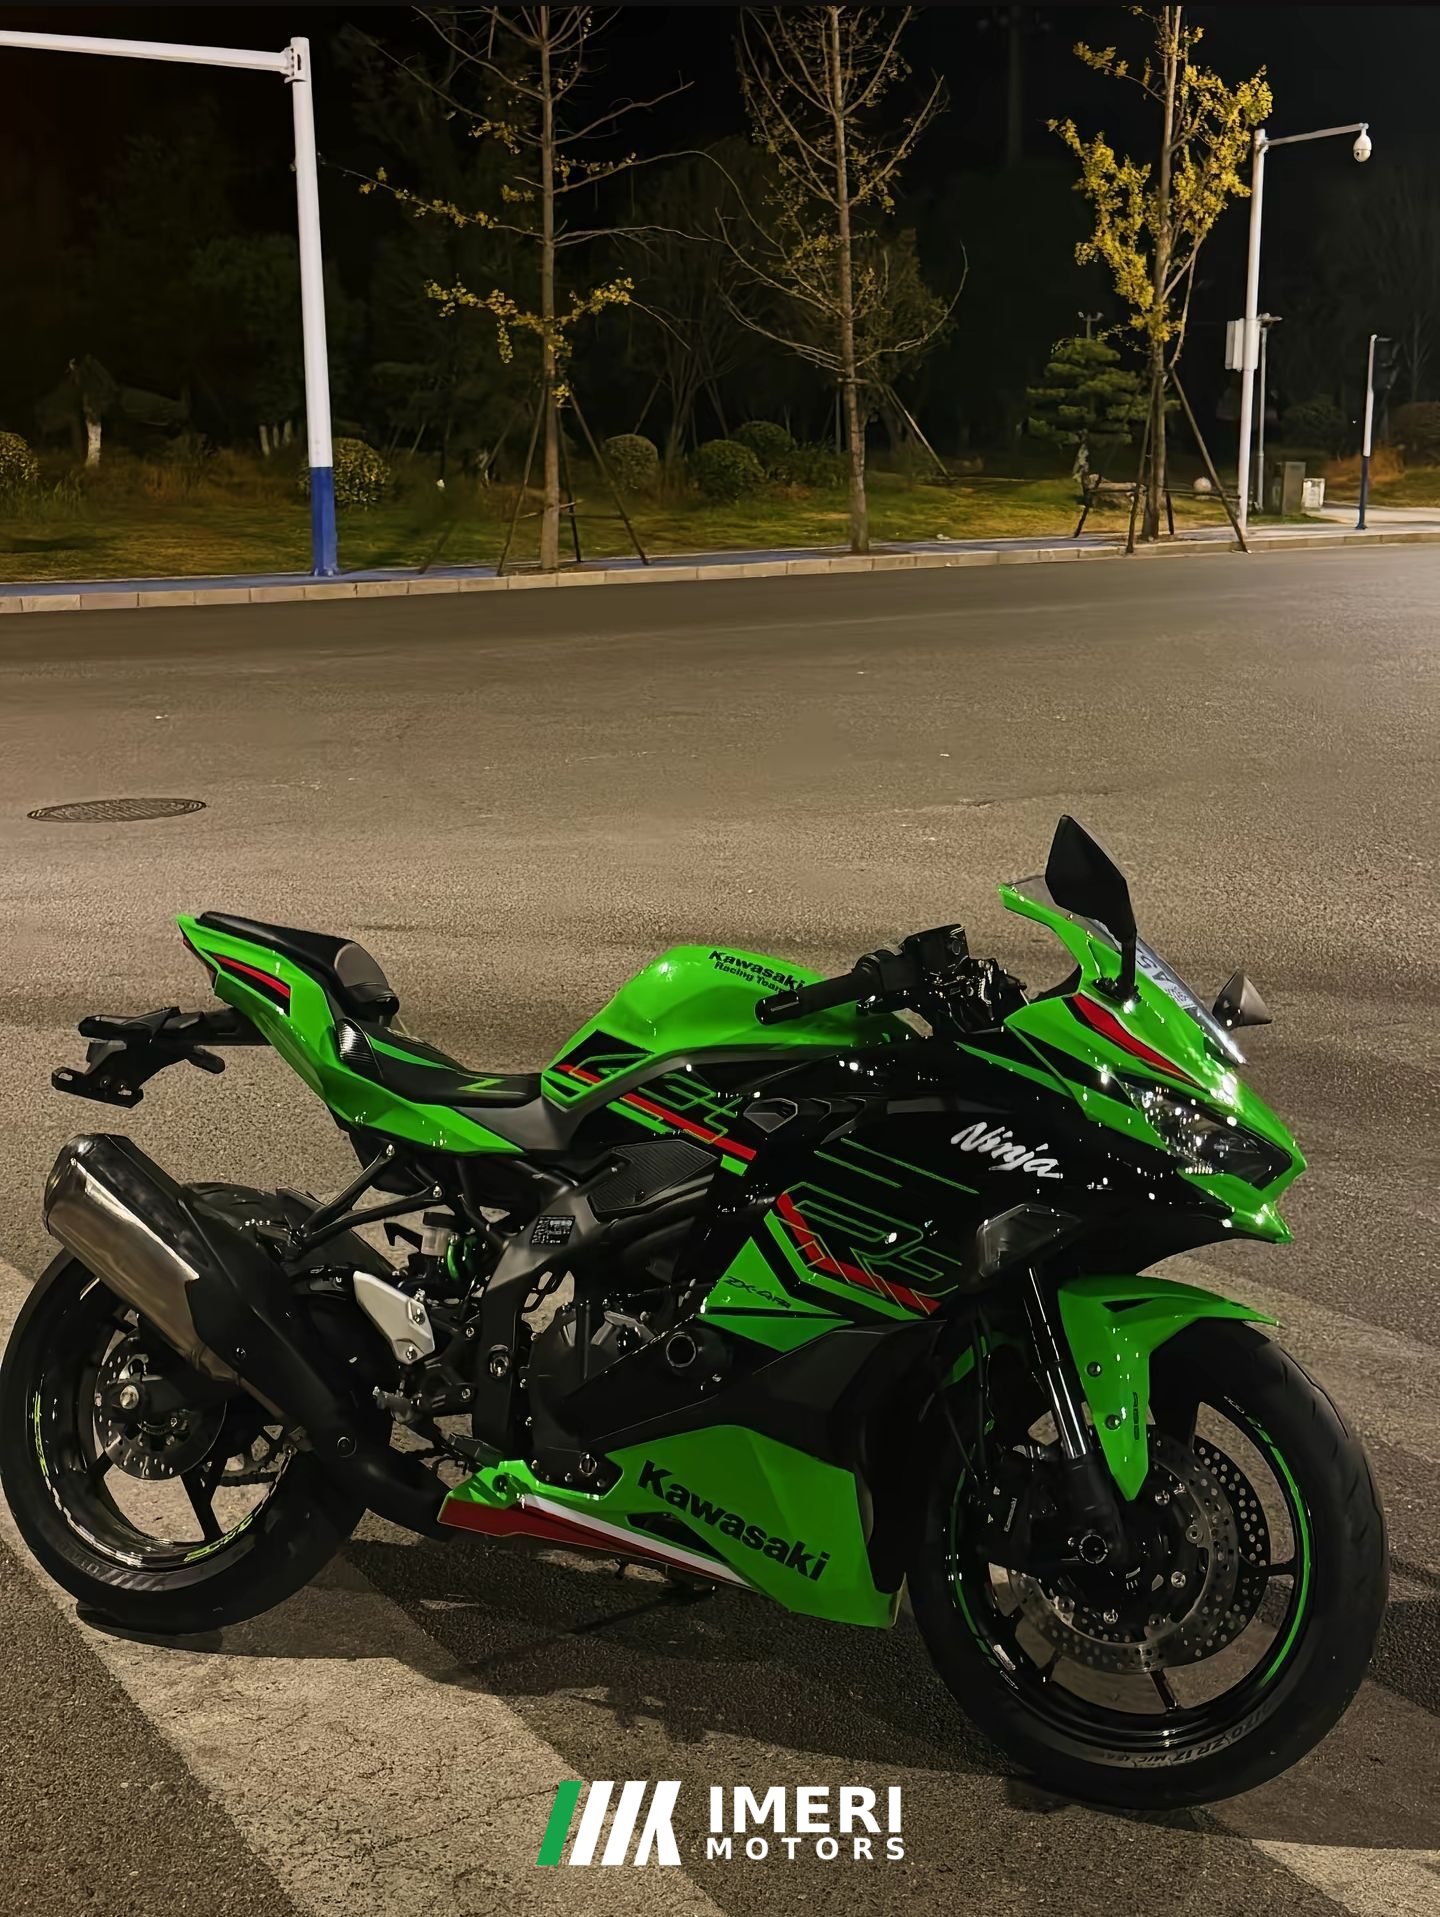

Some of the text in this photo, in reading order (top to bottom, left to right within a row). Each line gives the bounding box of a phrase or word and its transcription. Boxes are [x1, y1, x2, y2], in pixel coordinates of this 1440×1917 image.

[708, 950, 806, 991] Kawasaki
[714, 961, 755, 982] Racing
[950, 1121, 1063, 1178] Ninja
[637, 1459, 831, 1582] Kawasaki
